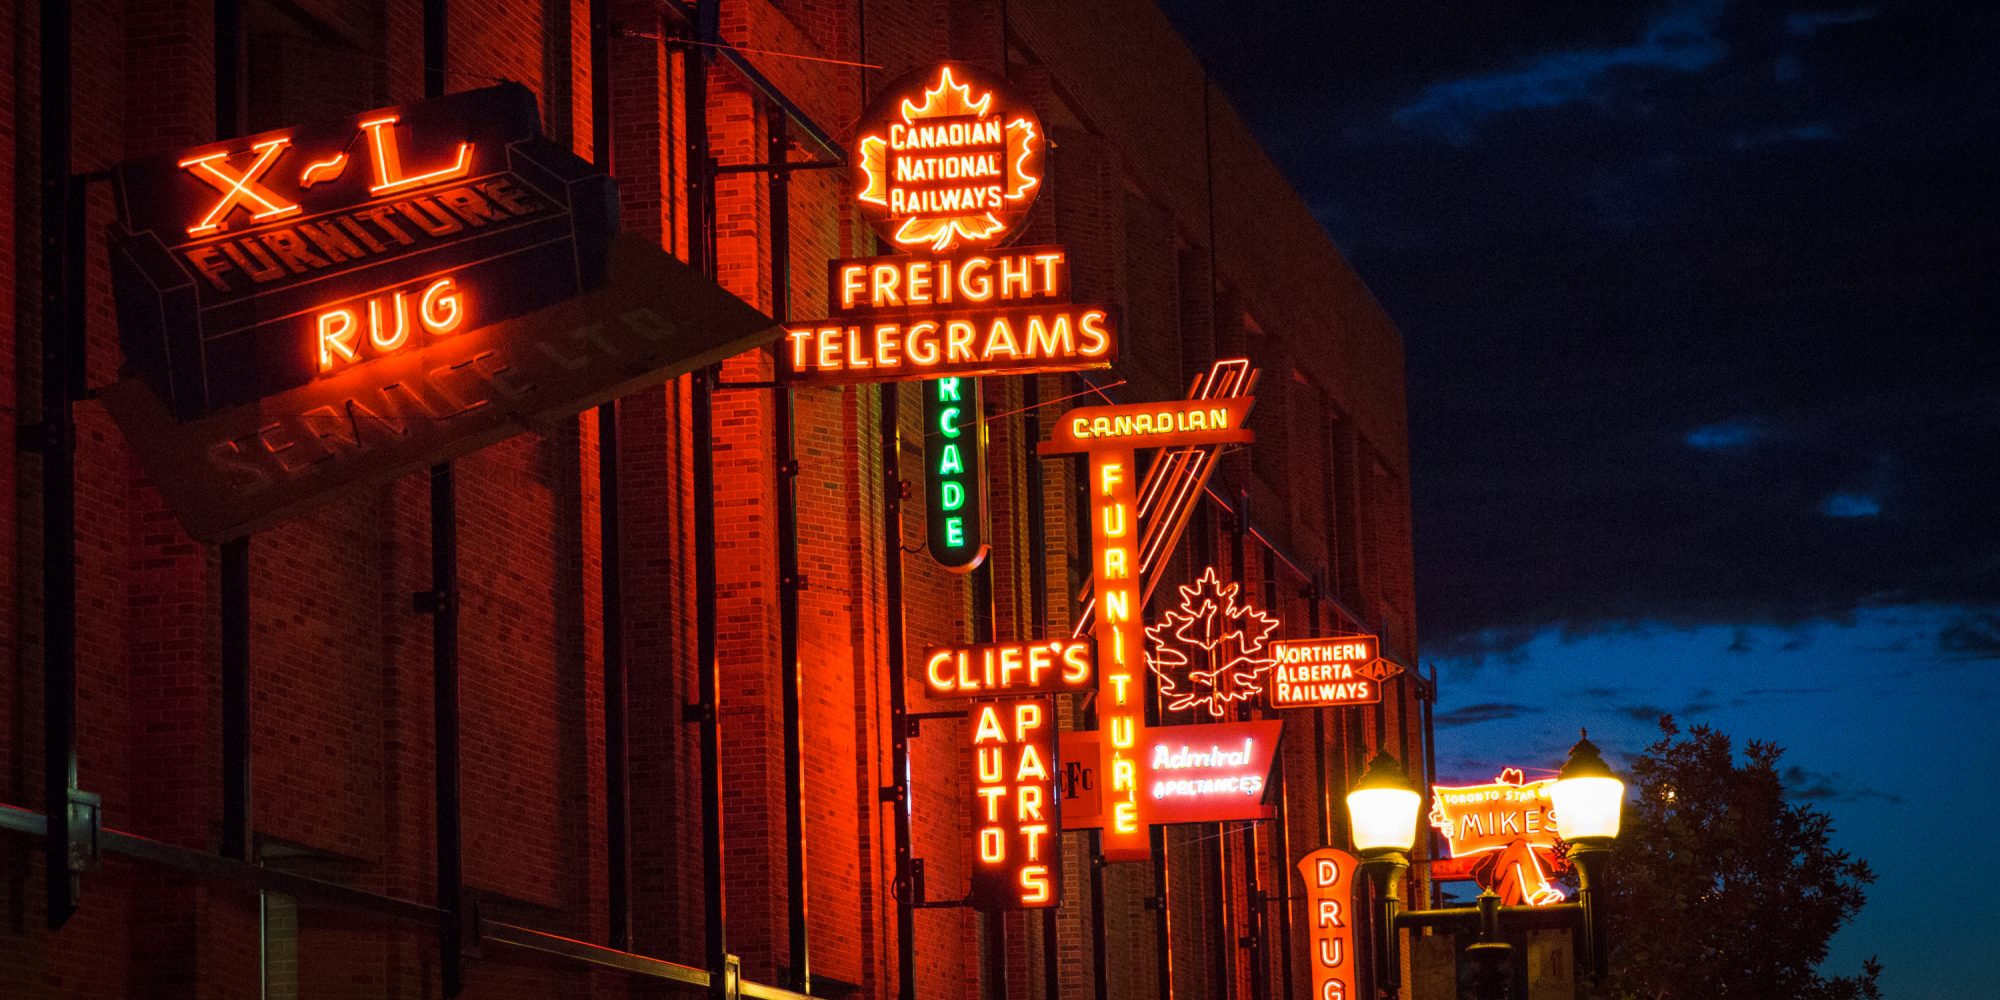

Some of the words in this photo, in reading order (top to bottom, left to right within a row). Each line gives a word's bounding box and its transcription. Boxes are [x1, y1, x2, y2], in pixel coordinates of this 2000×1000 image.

[890, 120, 1001, 150] CANADIAN
[897, 154, 1001, 182] NATIONAL
[890, 185, 1002, 213] RAILWAYS
[184, 177, 546, 292] FURNITURE
[841, 252, 1065, 310] FREIGHT
[315, 275, 464, 373] RUG
[785, 310, 1110, 373] TELEGRAMS
[1072, 408, 1229, 440] CANADIAN
[927, 642, 1090, 690] CLIFF'S
[1101, 464, 1138, 835] FURNITURE
[1275, 643, 1367, 664] NORTHERN
[1277, 664, 1353, 683] ALBERTA
[1278, 682, 1369, 702] RAILWAYS
[1152, 738, 1253, 770] Admiral
[974, 706, 1007, 864] AUTO
[1015, 703, 1048, 903] PARTS
[1444, 791, 1500, 804] TORONTO
[1505, 789, 1536, 801] STAR
[1316, 857, 1346, 1000] DRUG
